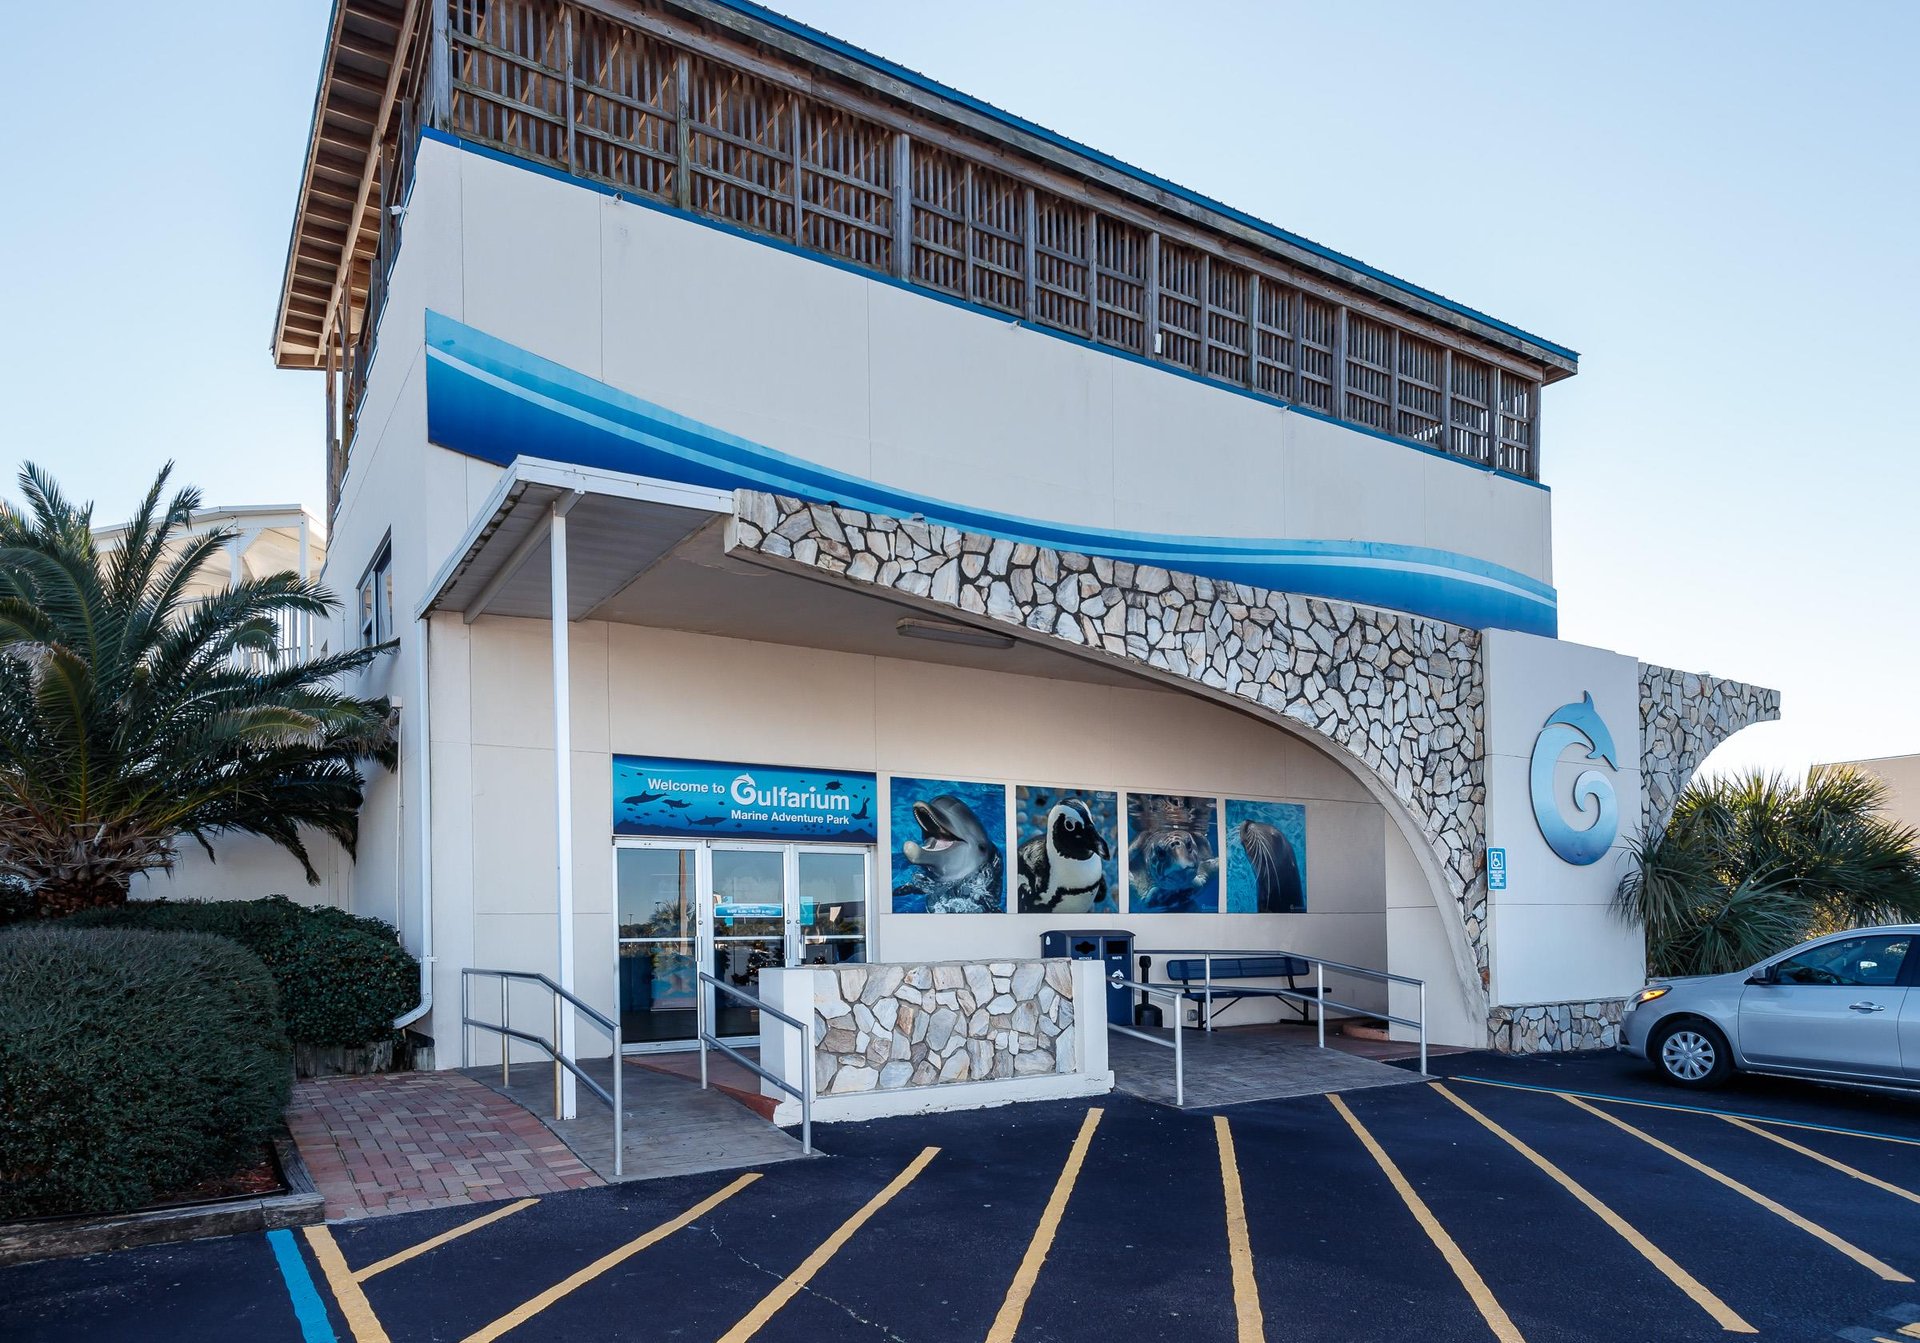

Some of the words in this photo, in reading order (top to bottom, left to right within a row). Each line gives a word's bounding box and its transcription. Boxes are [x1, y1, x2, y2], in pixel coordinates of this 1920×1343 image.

[648, 778, 709, 793] Welcome
[712, 783, 725, 794] to
[731, 773, 849, 810] Gulfarium
[731, 810, 769, 821] Marine
[771, 812, 824, 824] Adventure
[826, 814, 850, 825] Park
